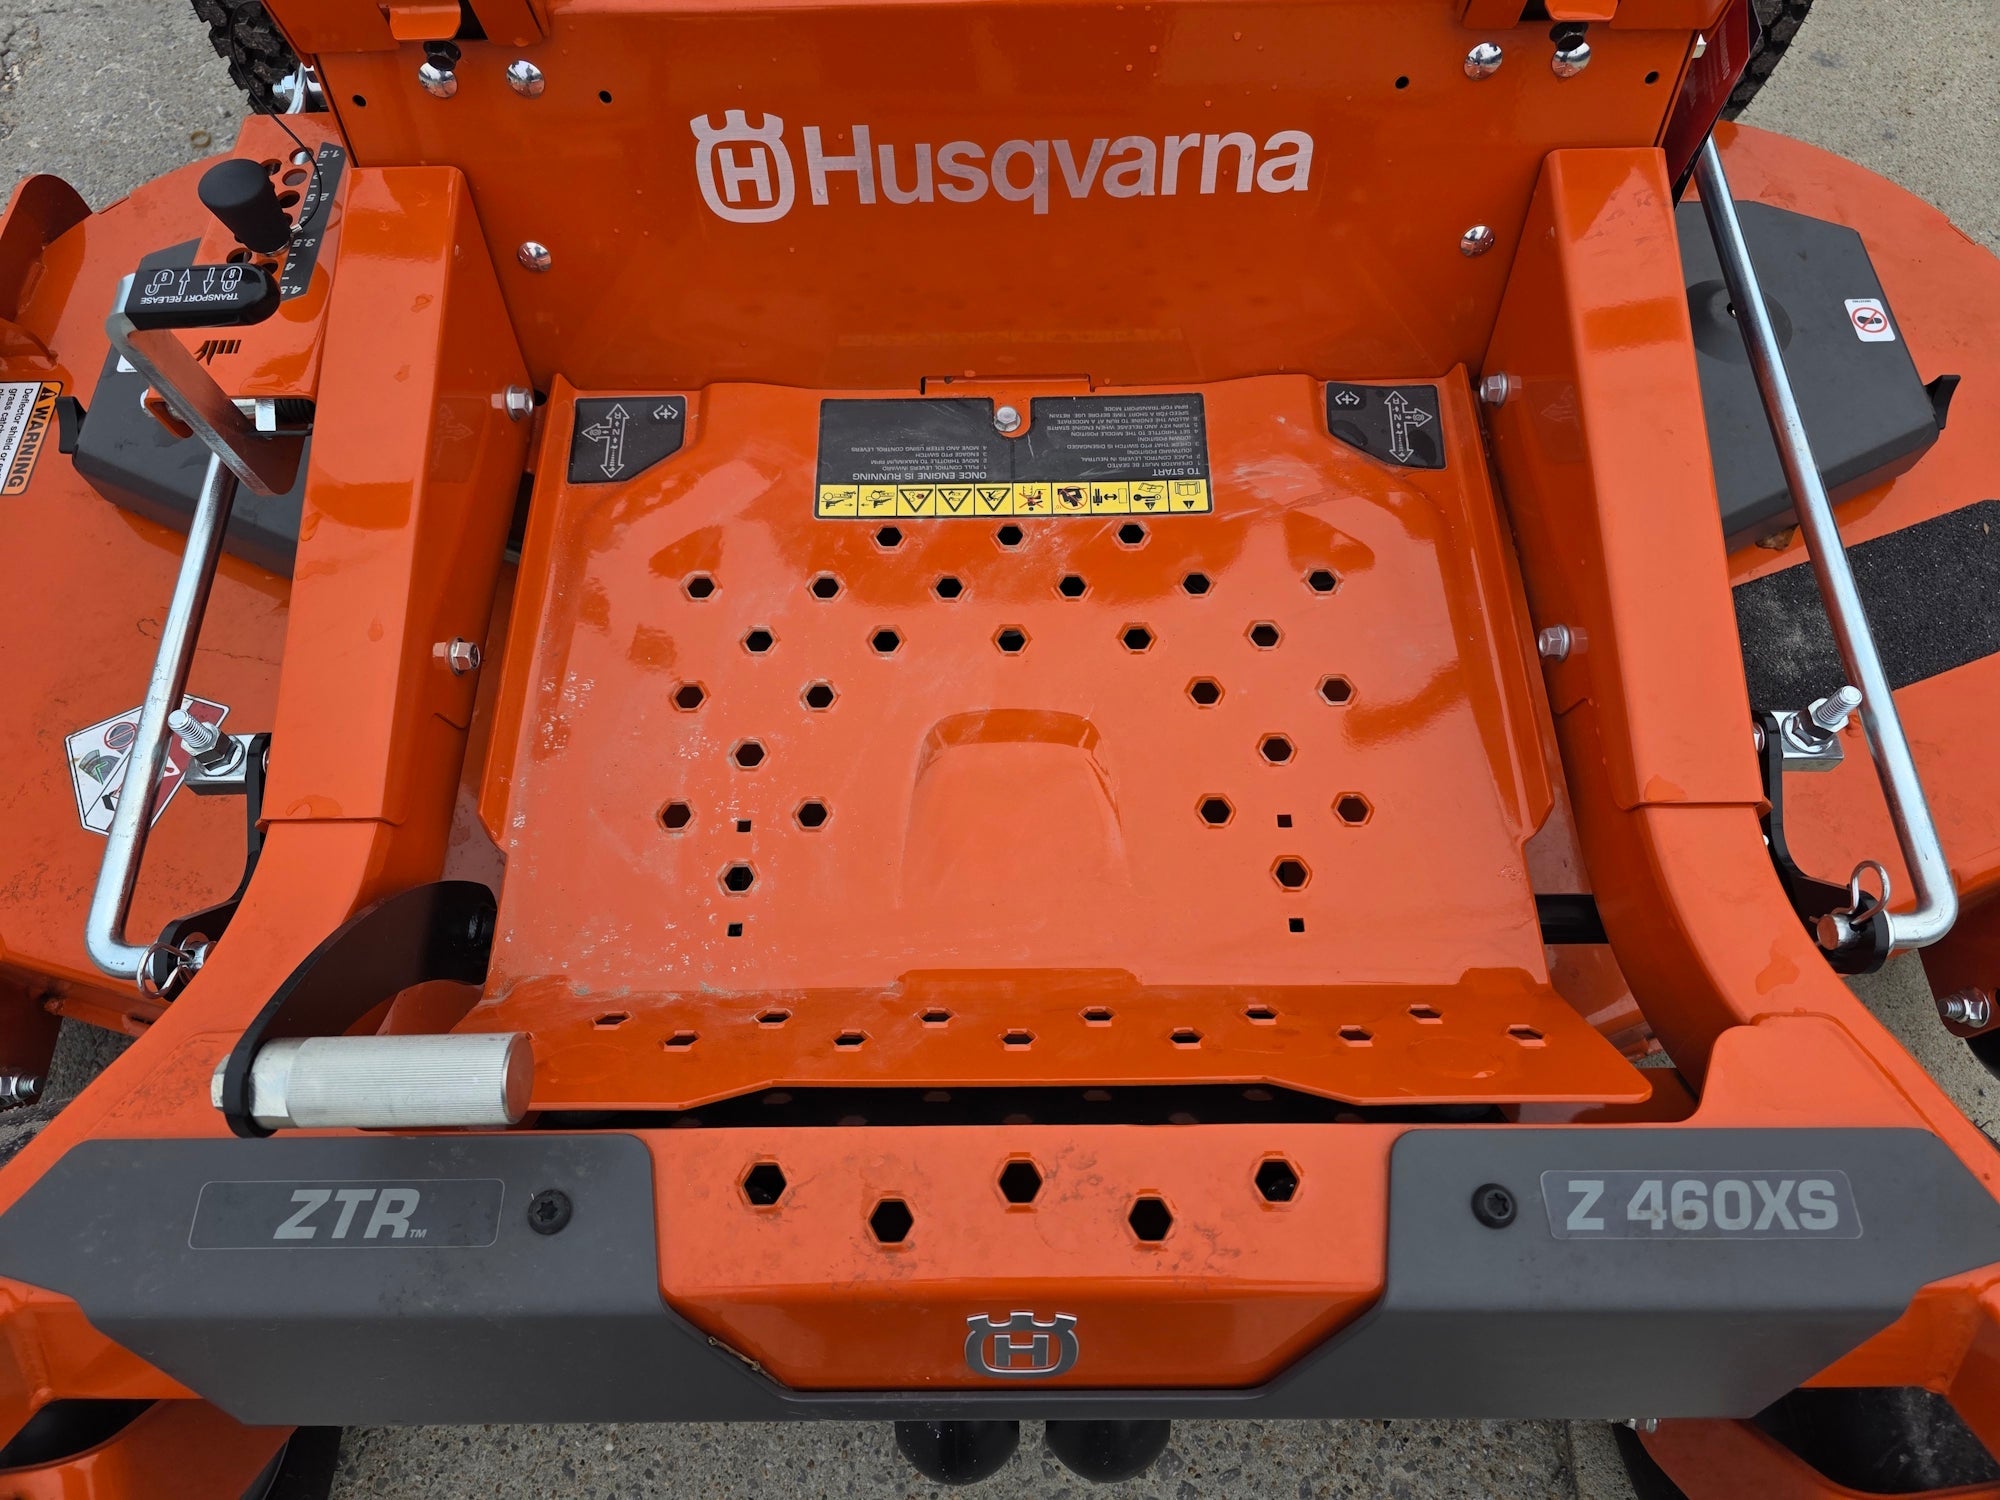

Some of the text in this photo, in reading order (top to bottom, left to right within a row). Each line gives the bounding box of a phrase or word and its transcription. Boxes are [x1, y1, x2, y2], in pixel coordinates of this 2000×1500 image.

[319, 150, 341, 159] 1.5
[803, 124, 1314, 214] Husqvarna
[306, 192, 330, 202] 25
[292, 238, 316, 247] 3.5
[284, 262, 296, 271] 4
[140, 293, 239, 305] TRANSPORT RELEASE
[4, 388, 18, 411] grass
[16, 388, 33, 424] Deflector
[3, 425, 18, 451] shield
[8, 405, 51, 488] WARNING
[917, 472, 956, 480] ENGINE
[273, 1188, 420, 1239] ZTR
[1566, 1180, 1839, 1231] Z 460XS
